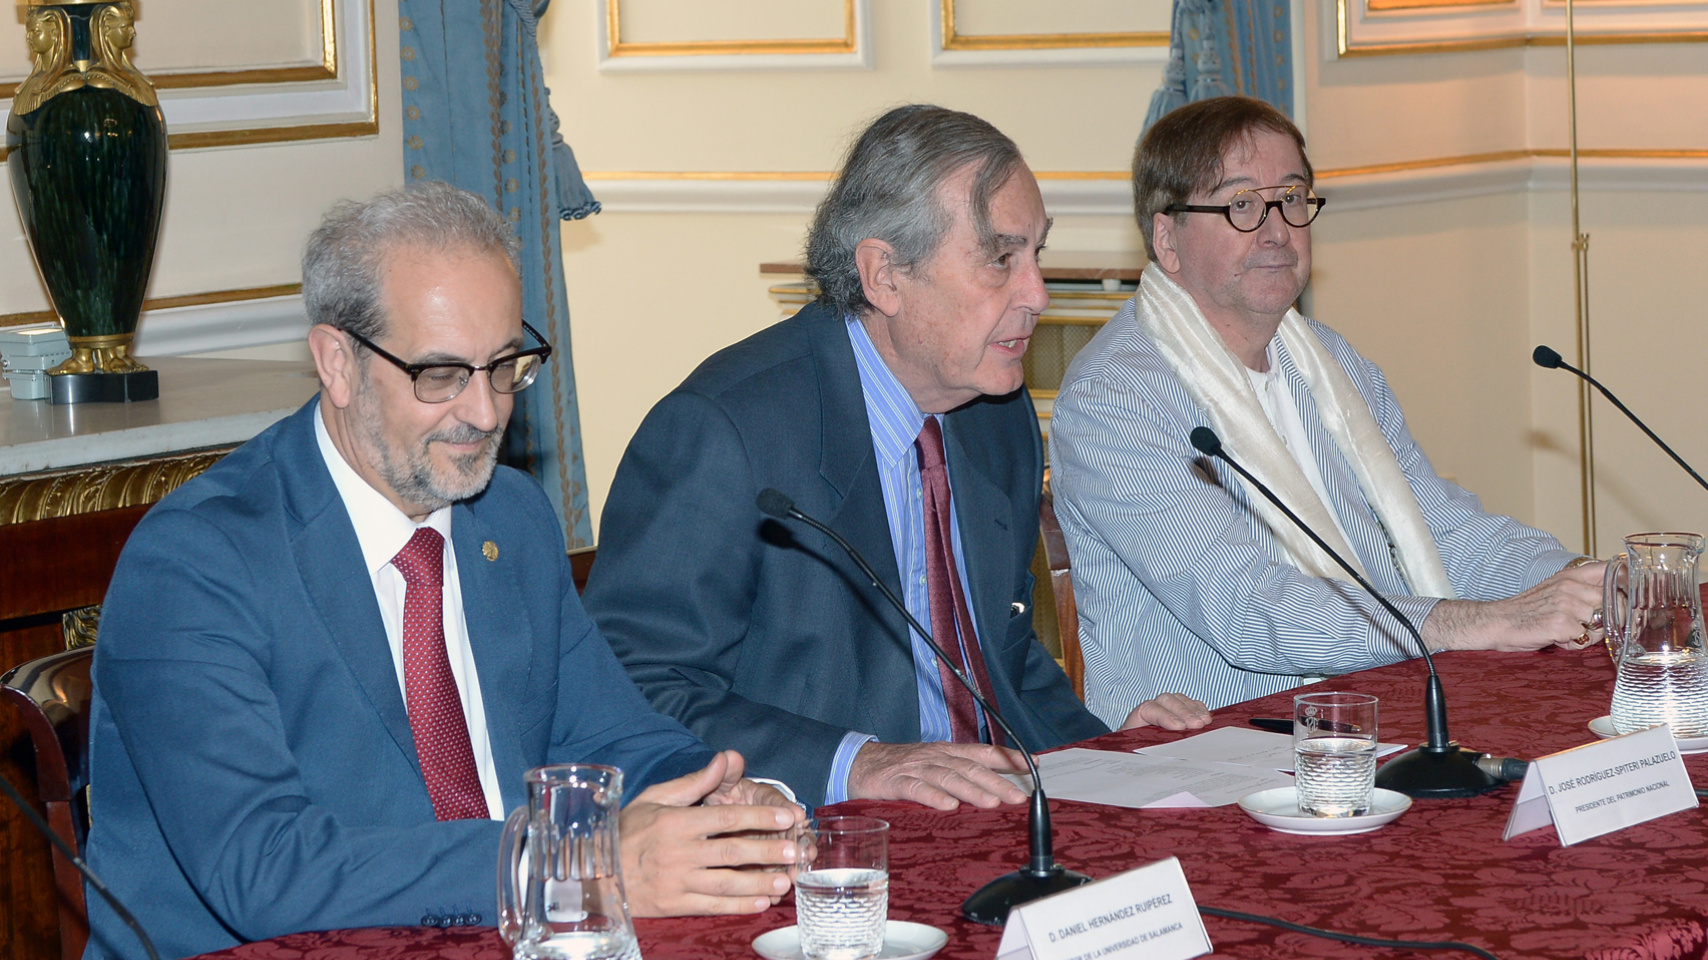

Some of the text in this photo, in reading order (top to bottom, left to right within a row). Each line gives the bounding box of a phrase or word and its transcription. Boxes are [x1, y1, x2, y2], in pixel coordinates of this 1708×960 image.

[1557, 779, 1575, 793] JOSÉ
[1575, 761, 1641, 786] RODRÍGUEZ-SPITERI
[1640, 750, 1676, 768] PALAZUELO
[1575, 780, 1670, 813] PRESIDENTE DEL PATRIMONIO NACIONAL
[1058, 923, 1088, 940] DANIEL
[1088, 905, 1135, 929] HERNÁNDEZ
[1135, 893, 1172, 914] RUIPÉREZ
[1084, 951, 1093, 960] DE
[1093, 950, 1102, 959] LA
[1102, 936, 1140, 955] UNIVERSIDAD
[1140, 933, 1148, 943] DE
[1148, 922, 1183, 939] SALAMANCA
